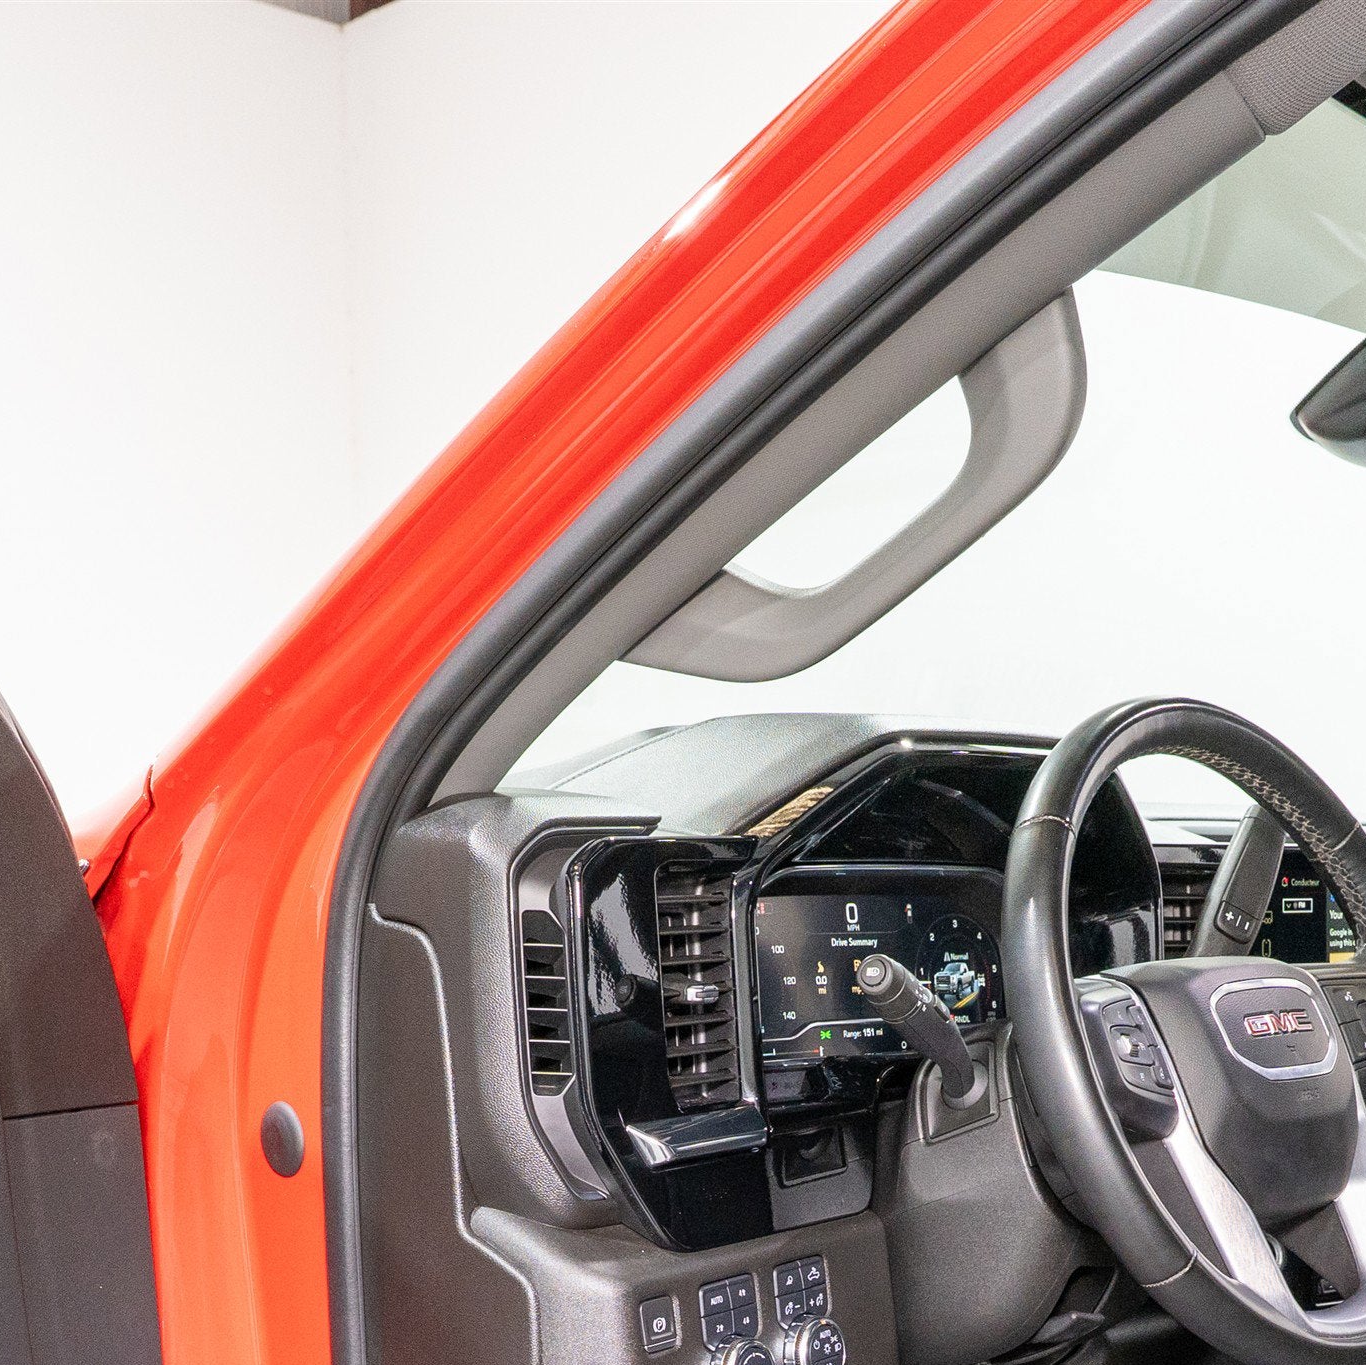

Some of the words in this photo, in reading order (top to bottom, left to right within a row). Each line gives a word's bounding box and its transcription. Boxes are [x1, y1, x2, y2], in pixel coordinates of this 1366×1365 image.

[845, 902, 859, 924] 0
[846, 924, 860, 932] MPH
[952, 919, 958, 928] 3
[929, 933, 935, 941] 2
[976, 931, 982, 940] 4
[1329, 928, 1347, 938] Google
[830, 938, 848, 947] Drive
[848, 938, 878, 948] Summary
[771, 945, 785, 954] 100
[950, 952, 969, 960] Normal
[920, 967, 924, 975] 1
[991, 964, 997, 973] 5
[783, 976, 796, 985] 120
[818, 986, 827, 994] mi
[991, 1000, 997, 1009] 6
[782, 1011, 796, 1020] 140
[1243, 1009, 1314, 1038] GMC
[843, 1030, 862, 1040] Range:
[862, 1028, 875, 1037] 151
[710, 1295, 724, 1306] AUTO
[819, 1329, 832, 1340] AUTO
